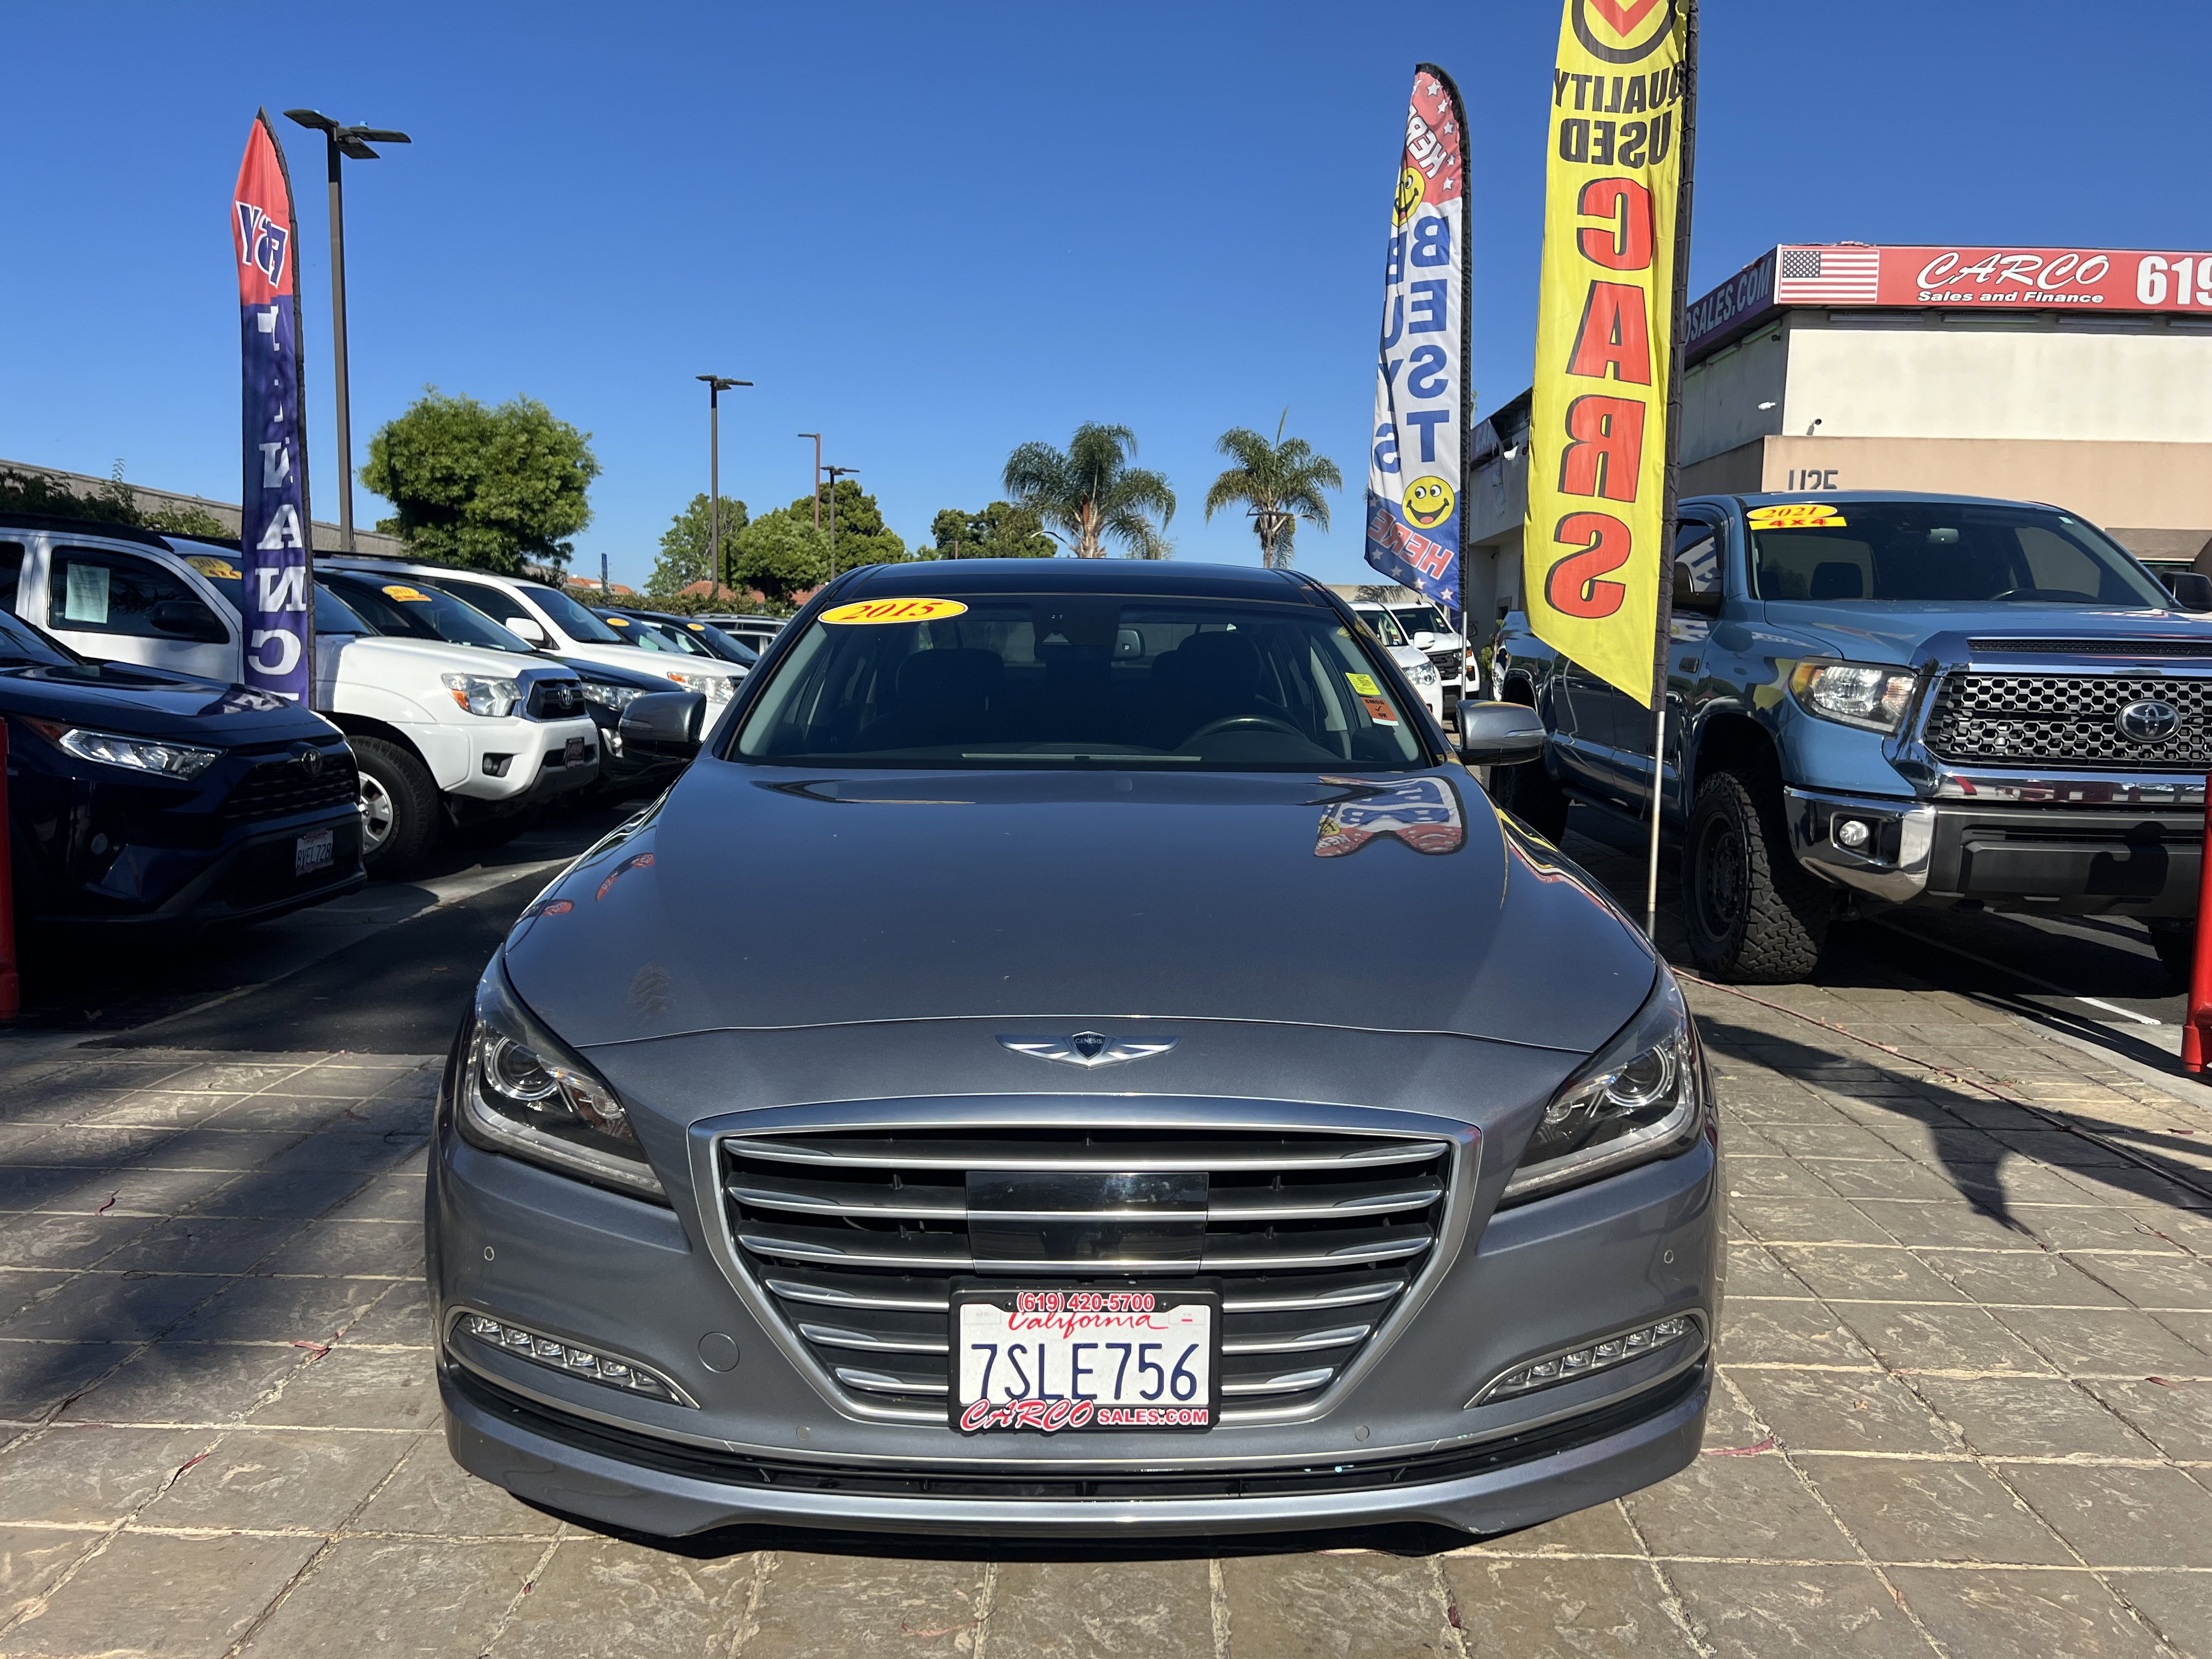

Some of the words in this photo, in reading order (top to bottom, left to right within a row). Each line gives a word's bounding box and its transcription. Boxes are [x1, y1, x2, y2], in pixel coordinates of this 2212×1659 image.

[1916, 252, 2110, 290] CARCO
[1917, 291, 1973, 302] Sales
[1979, 291, 2018, 303] and
[2023, 292, 2104, 303] Finance
[1763, 507, 1817, 518] 2021
[839, 602, 944, 620] 2015
[1017, 1292, 1065, 1312] (619)
[1067, 1293, 1155, 1312] 420-5700
[1008, 1312, 1169, 1339] California
[971, 1343, 1200, 1401] 7SLE756
[960, 1398, 1094, 1432] CARCO
[1097, 1408, 1209, 1426] SALES.COM
